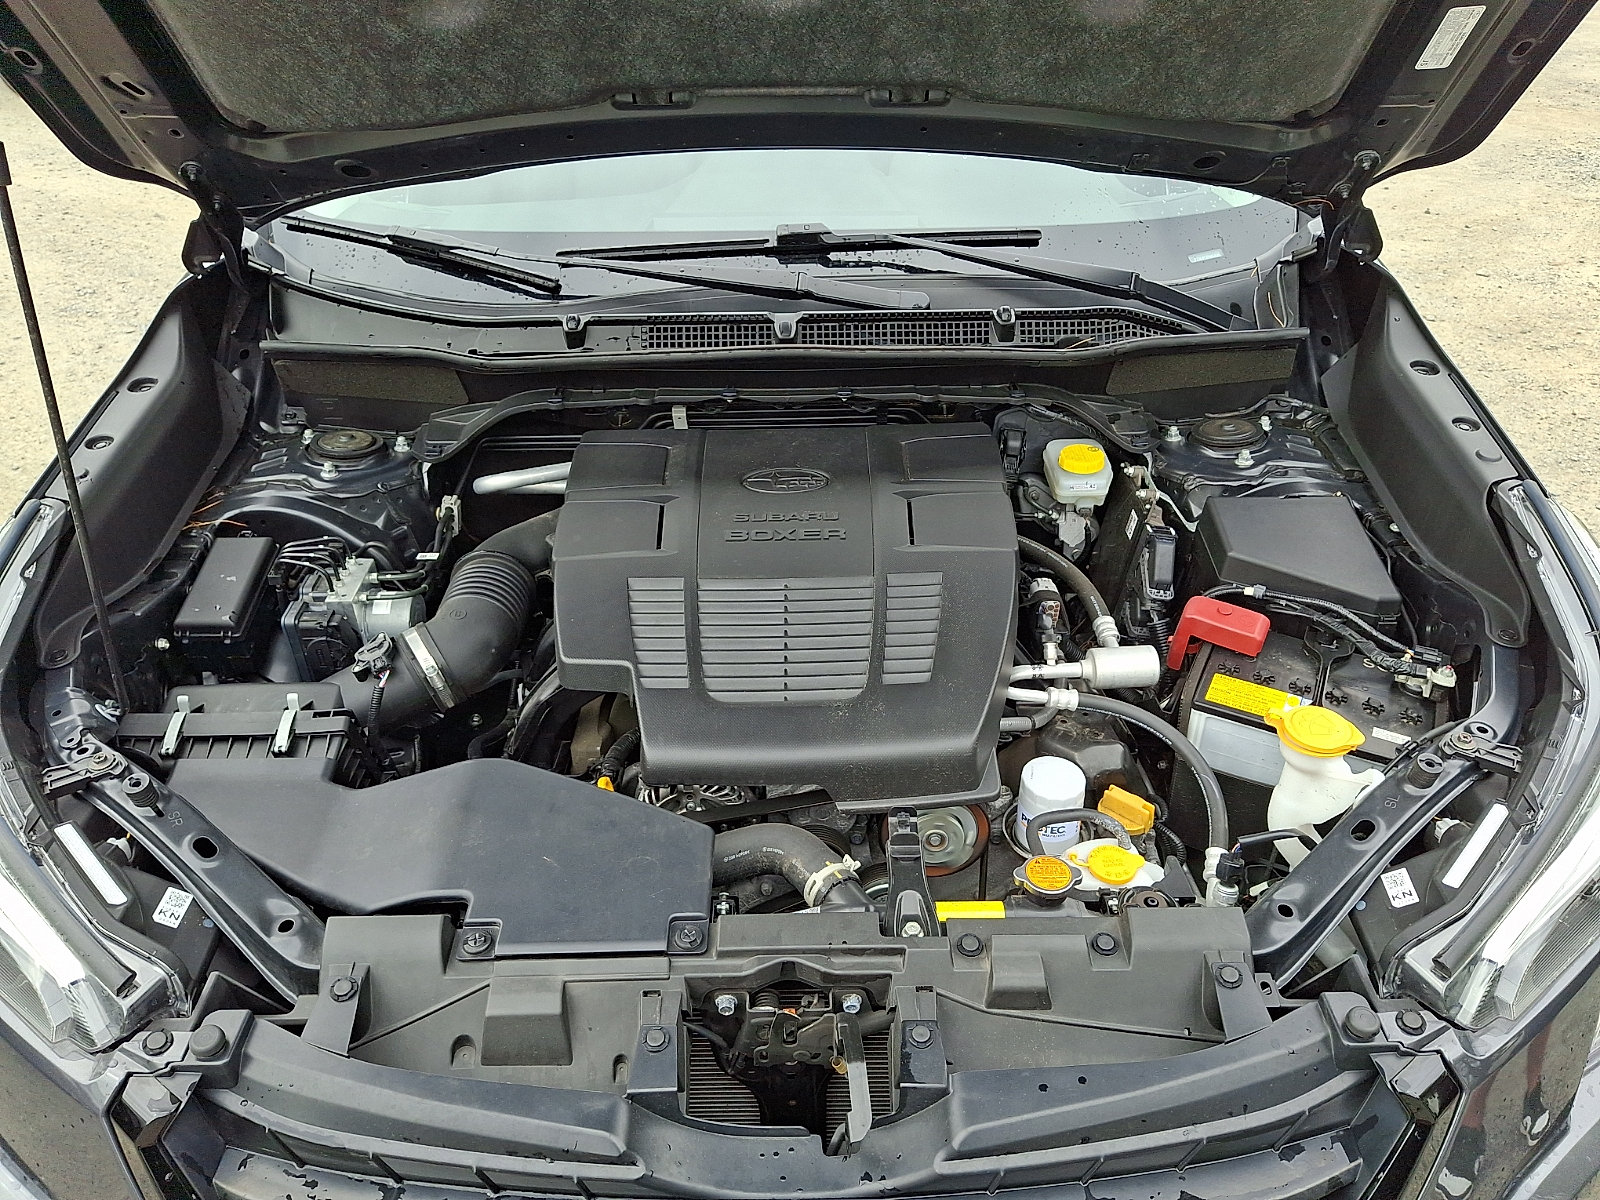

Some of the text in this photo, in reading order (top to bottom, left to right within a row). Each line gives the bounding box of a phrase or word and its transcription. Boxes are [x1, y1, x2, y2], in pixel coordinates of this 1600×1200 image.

[733, 511, 840, 523] SUBARU
[725, 528, 848, 542] BOXER
[1384, 795, 1401, 809] SL
[168, 811, 184, 828] SR
[1391, 889, 1413, 902] KN
[158, 908, 181, 921] KN
